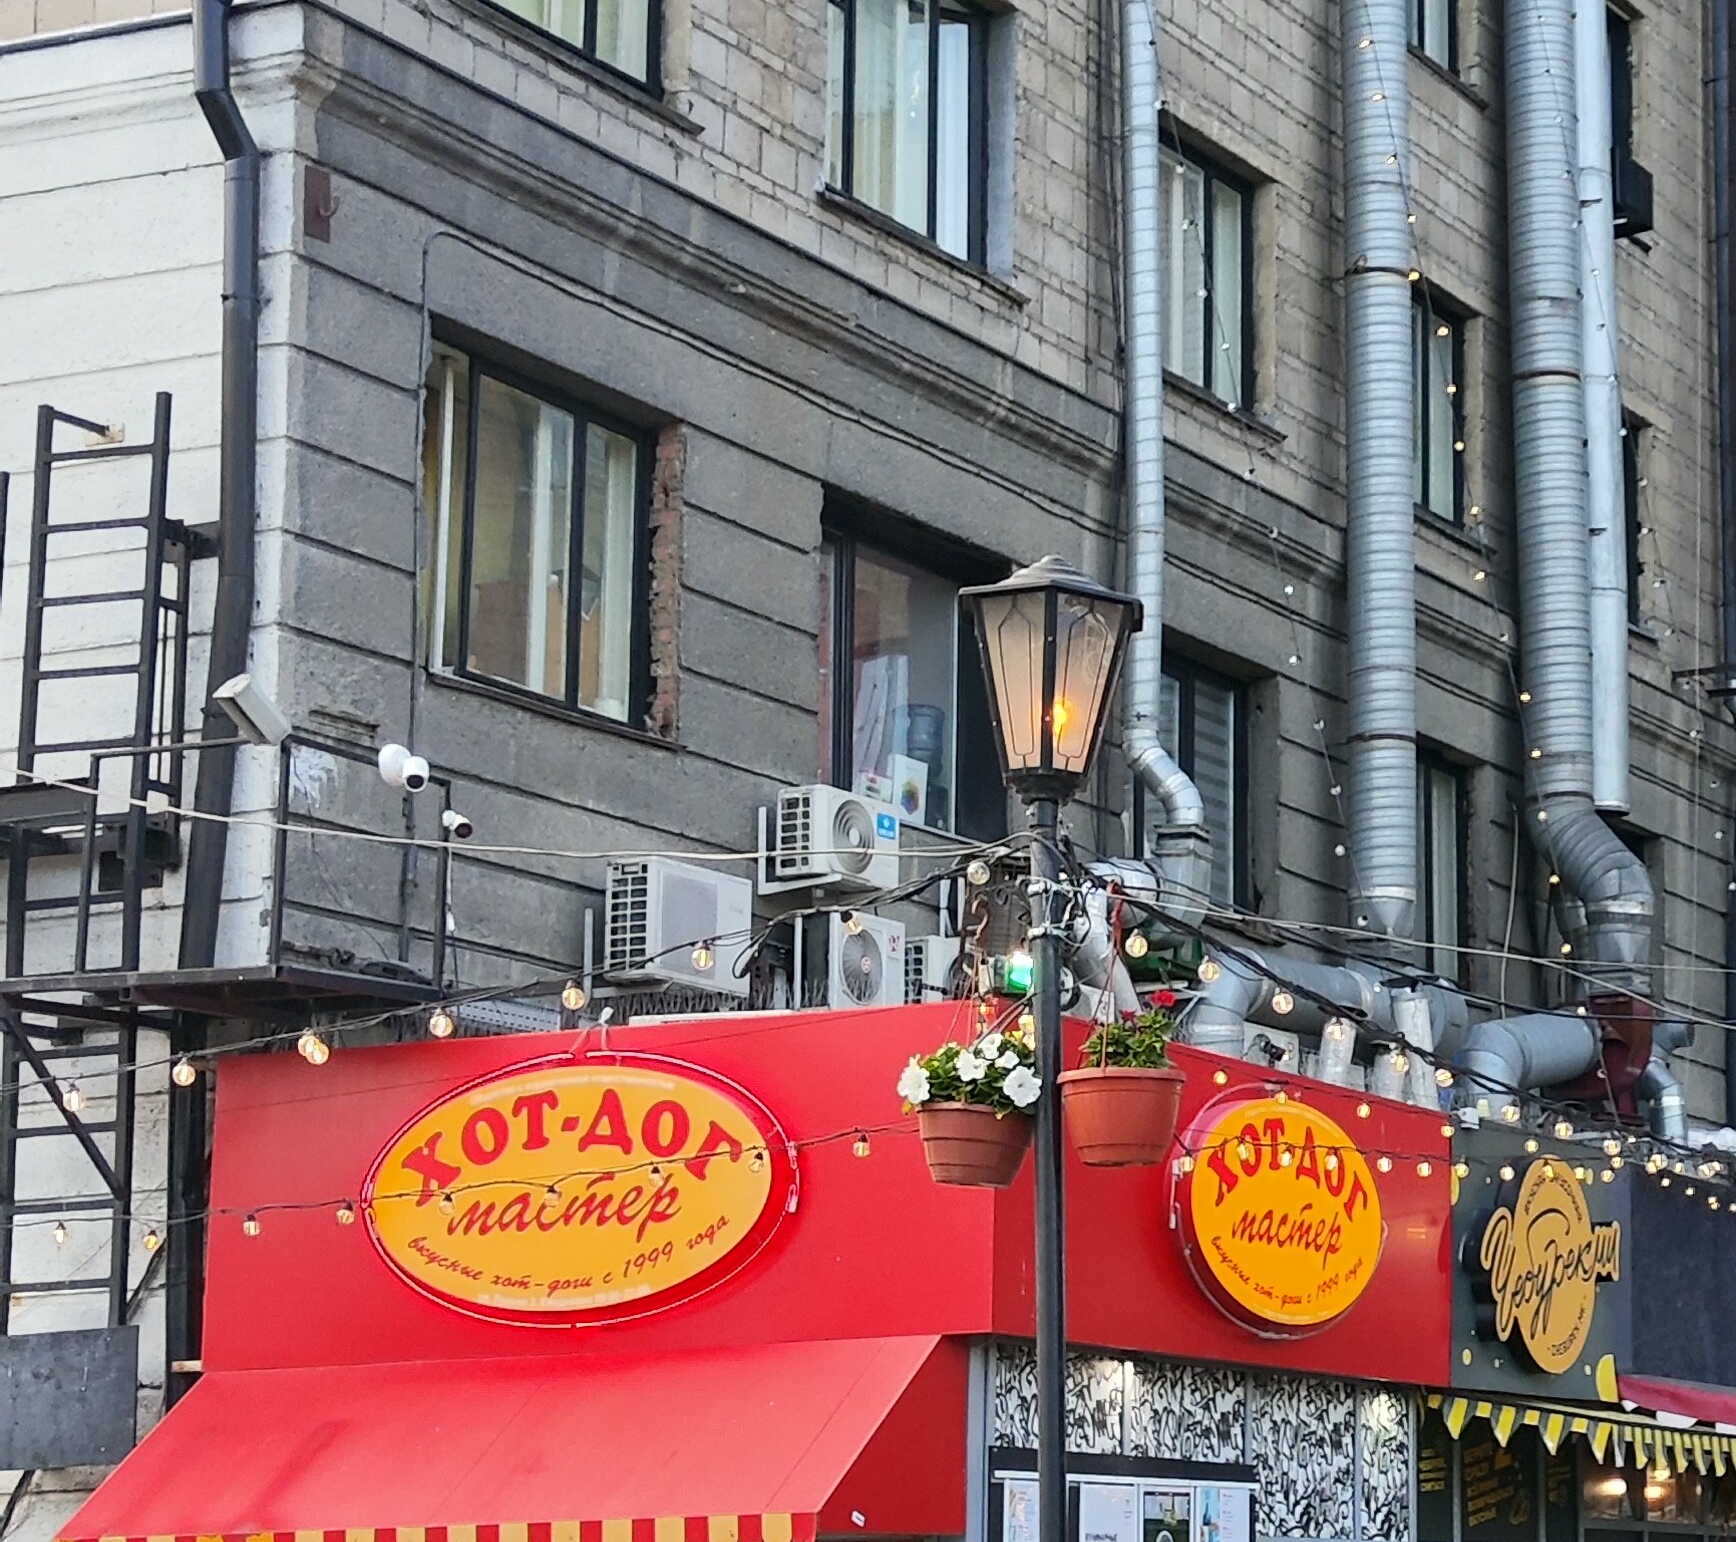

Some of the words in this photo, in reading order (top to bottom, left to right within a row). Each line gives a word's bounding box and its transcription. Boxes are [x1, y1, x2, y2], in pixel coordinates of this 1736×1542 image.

[401, 1088, 743, 1207] ХОТ-ДОГ
[446, 1171, 683, 1243] мастер
[1231, 1202, 1344, 1271] мастер
[407, 1235, 484, 1281] вкусные
[490, 1274, 594, 1298] хот-доги
[602, 1272, 614, 1285] с
[623, 1240, 674, 1278] 1999
[685, 1214, 731, 1252] года
[1315, 1272, 1340, 1301] 1999
